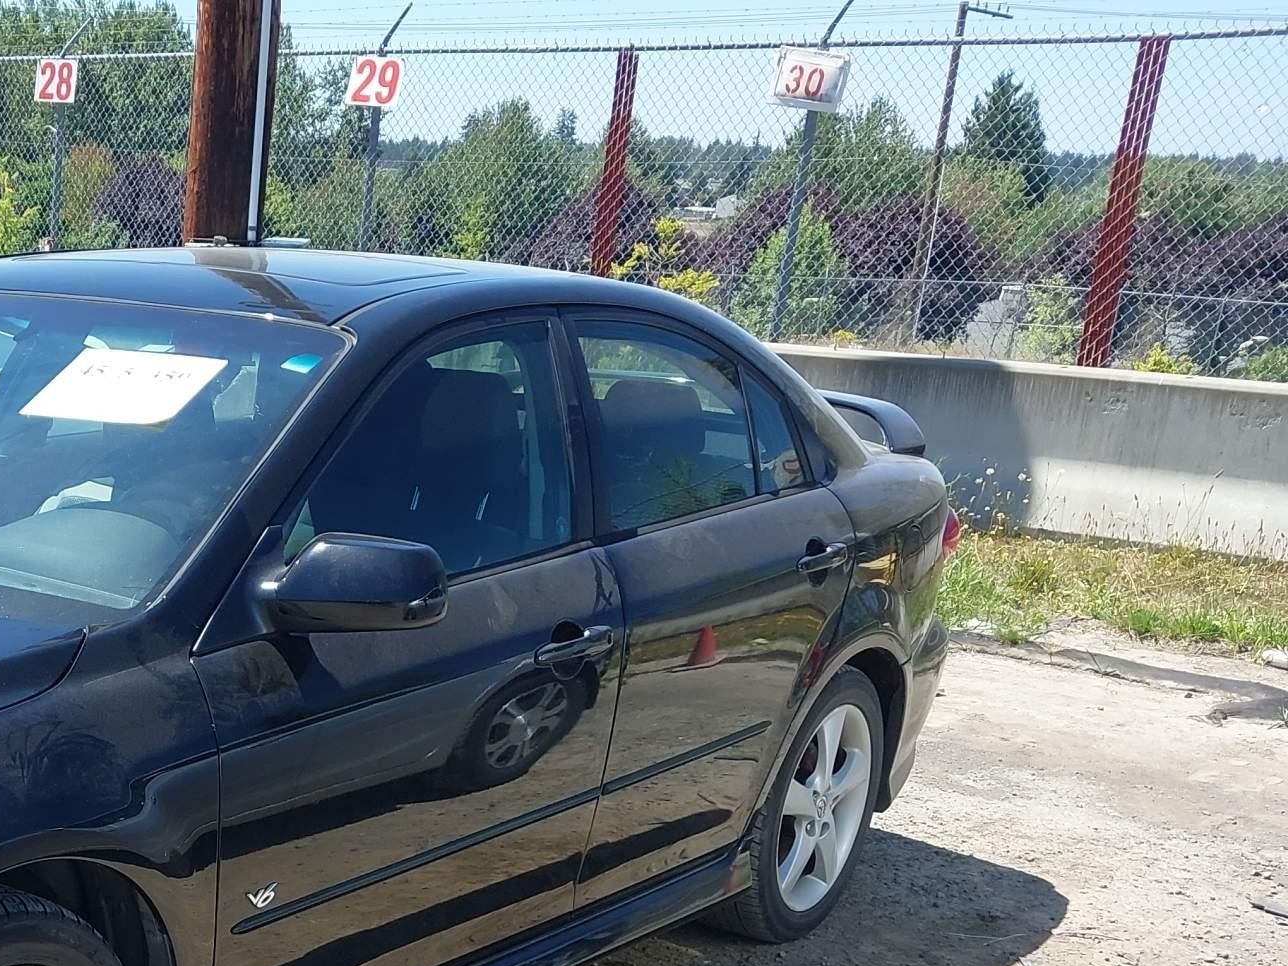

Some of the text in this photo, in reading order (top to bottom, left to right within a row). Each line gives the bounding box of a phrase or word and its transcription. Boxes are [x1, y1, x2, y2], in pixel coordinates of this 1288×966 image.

[39, 62, 73, 100] 28
[351, 59, 400, 104] 29
[785, 64, 824, 97] 30
[246, 881, 279, 908] V6
